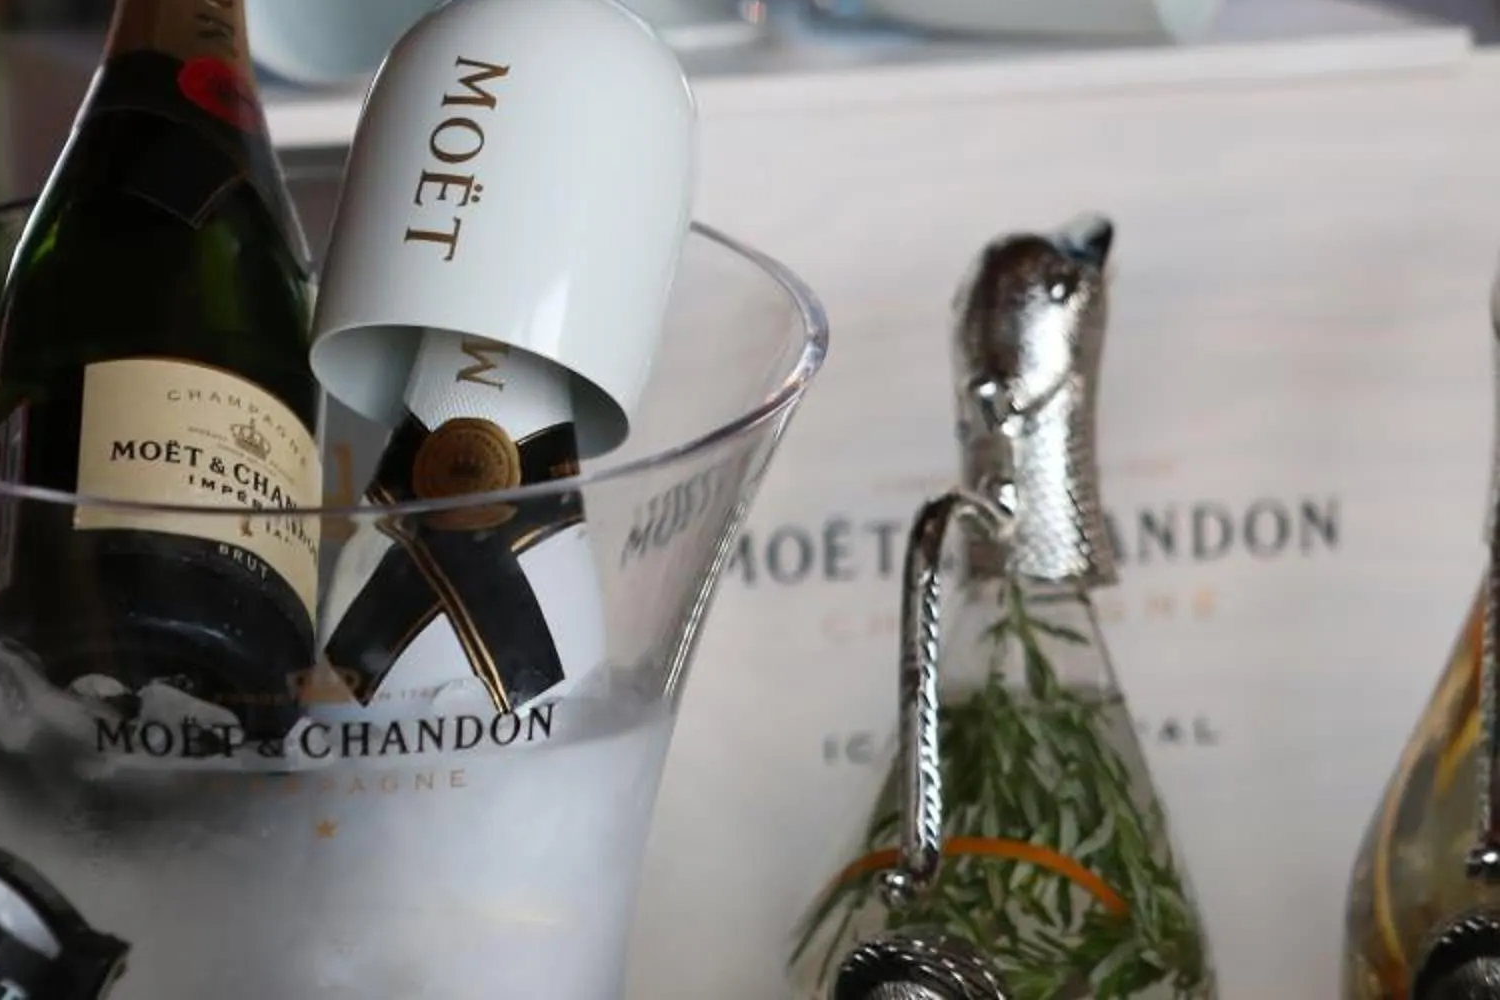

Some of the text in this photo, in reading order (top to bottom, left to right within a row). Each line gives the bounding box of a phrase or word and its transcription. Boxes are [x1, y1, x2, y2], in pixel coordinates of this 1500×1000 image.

[404, 55, 510, 261] MOËT
[167, 389, 307, 467] CHAMPAGNE
[110, 440, 203, 468] MOËT
[210, 455, 225, 476] &
[219, 544, 268, 580] BRUT
[94, 714, 247, 760] MOËT
[301, 703, 557, 760] CHANDON
